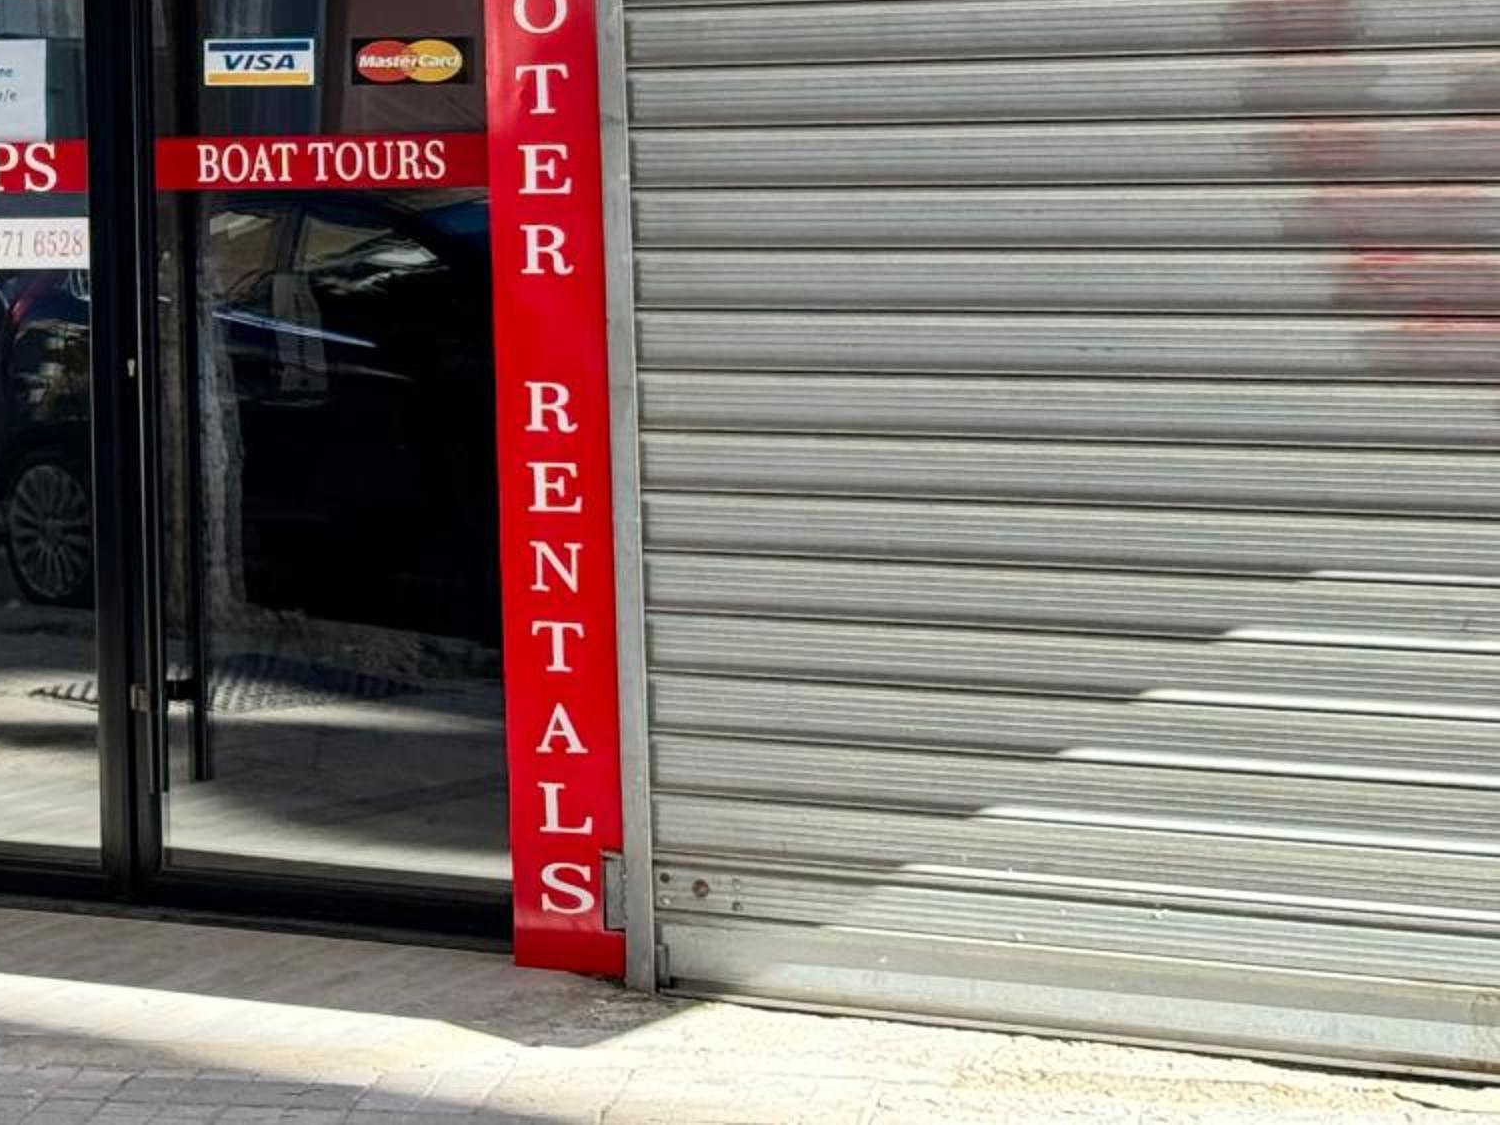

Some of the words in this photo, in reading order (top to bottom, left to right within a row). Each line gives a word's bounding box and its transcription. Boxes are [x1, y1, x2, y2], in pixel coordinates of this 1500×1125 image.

[223, 53, 296, 71] VISA
[359, 53, 458, 68] MasterCard
[197, 143, 298, 183] BOAT
[308, 139, 446, 181] TOURS
[33, 232, 84, 258] 6528
[525, 381, 596, 914] RENTALS
